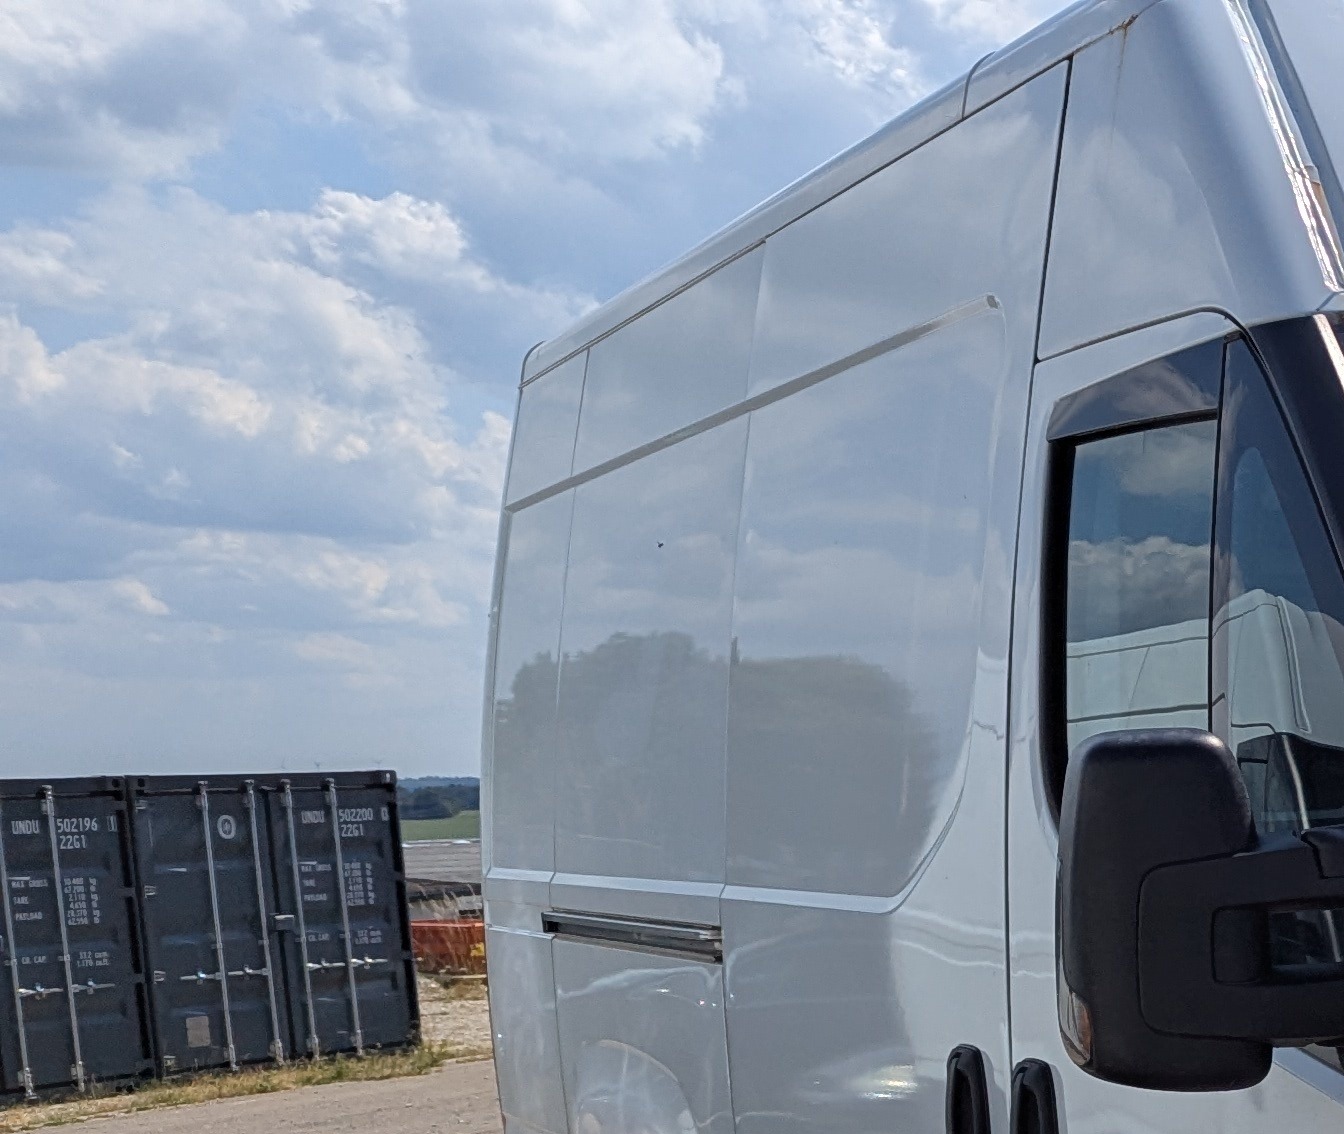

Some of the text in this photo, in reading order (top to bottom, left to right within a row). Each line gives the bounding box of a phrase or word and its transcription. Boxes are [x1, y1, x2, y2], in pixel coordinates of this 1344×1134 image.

[338, 808, 374, 822] 502200
[11, 820, 40, 834] UNDU
[56, 818, 98, 832] 502196
